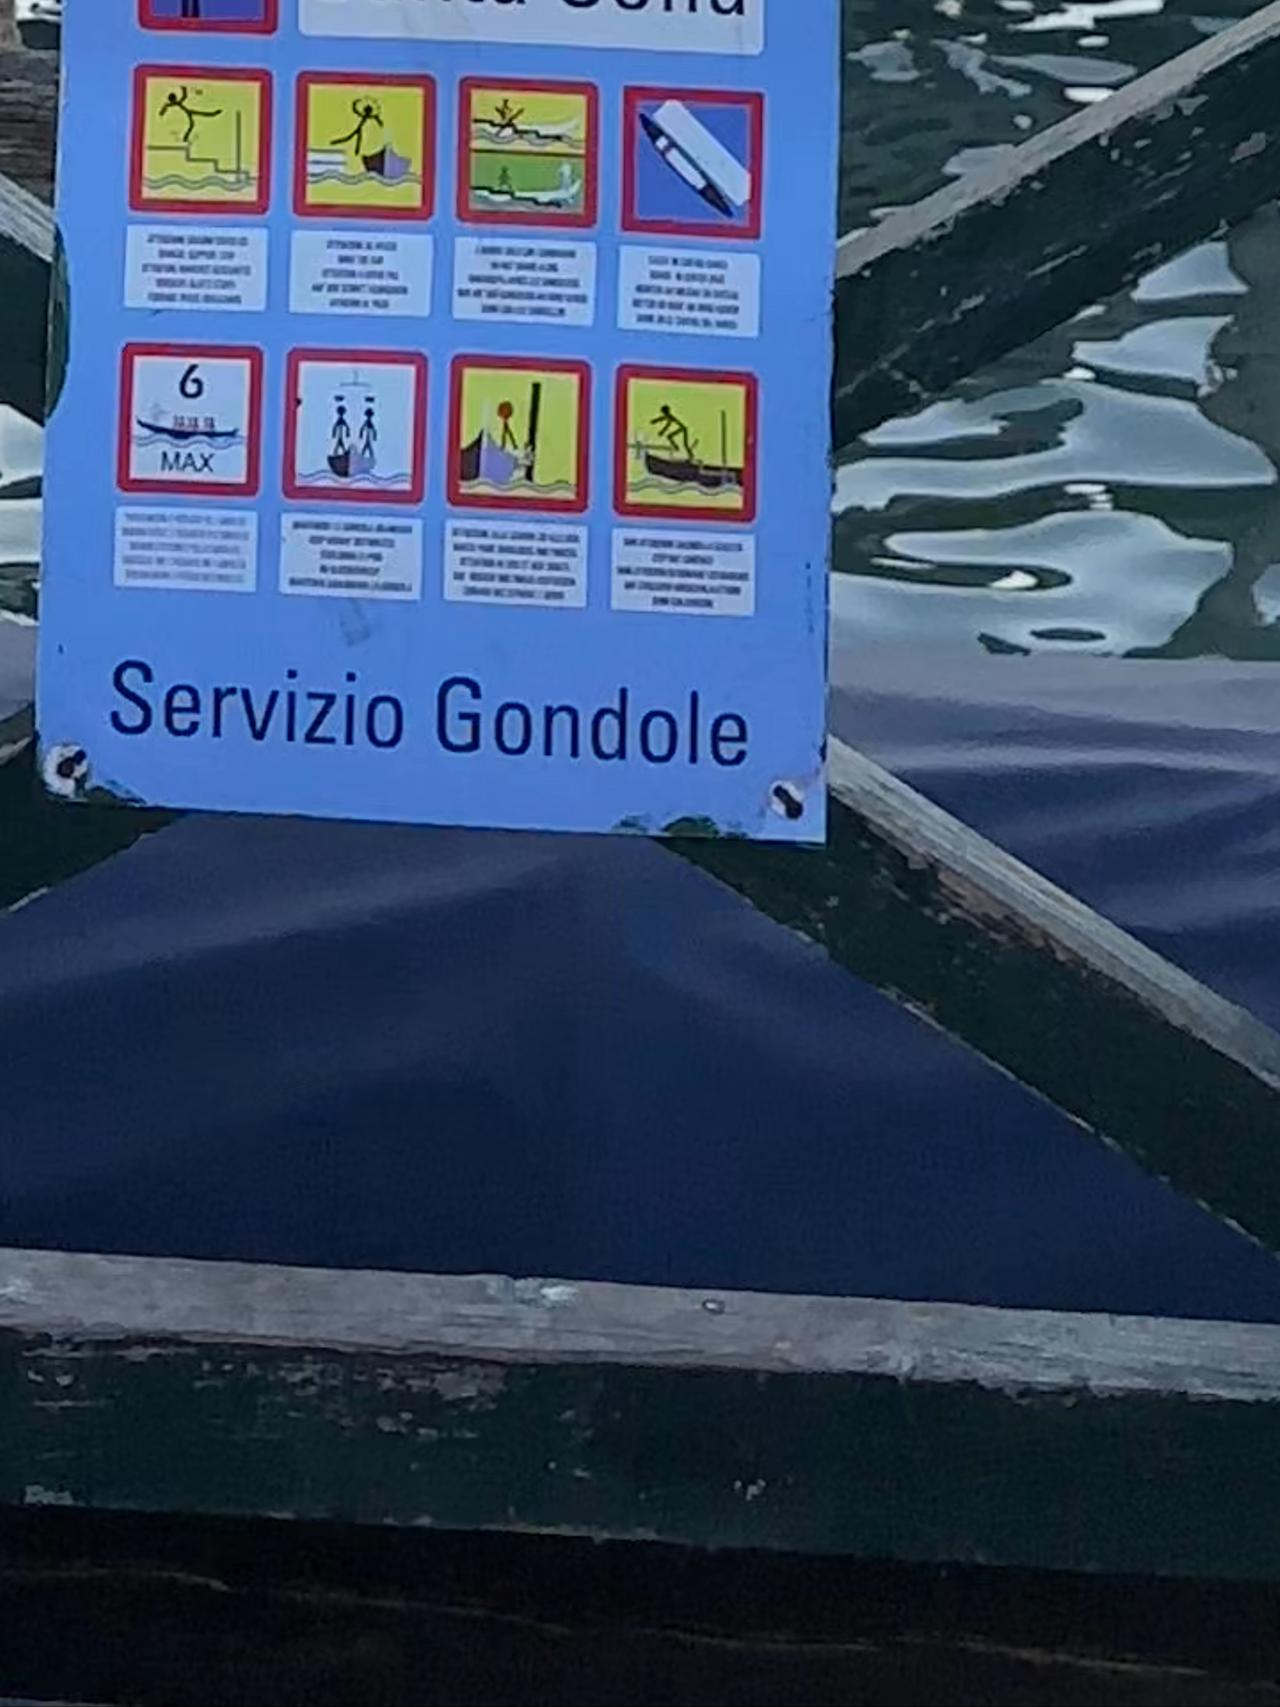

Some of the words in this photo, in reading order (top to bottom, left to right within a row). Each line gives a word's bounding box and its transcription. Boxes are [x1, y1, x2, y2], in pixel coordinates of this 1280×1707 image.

[178, 363, 205, 401] 6
[160, 450, 217, 474] MAX
[109, 658, 405, 750] Servizio
[435, 675, 749, 768] Gondole
